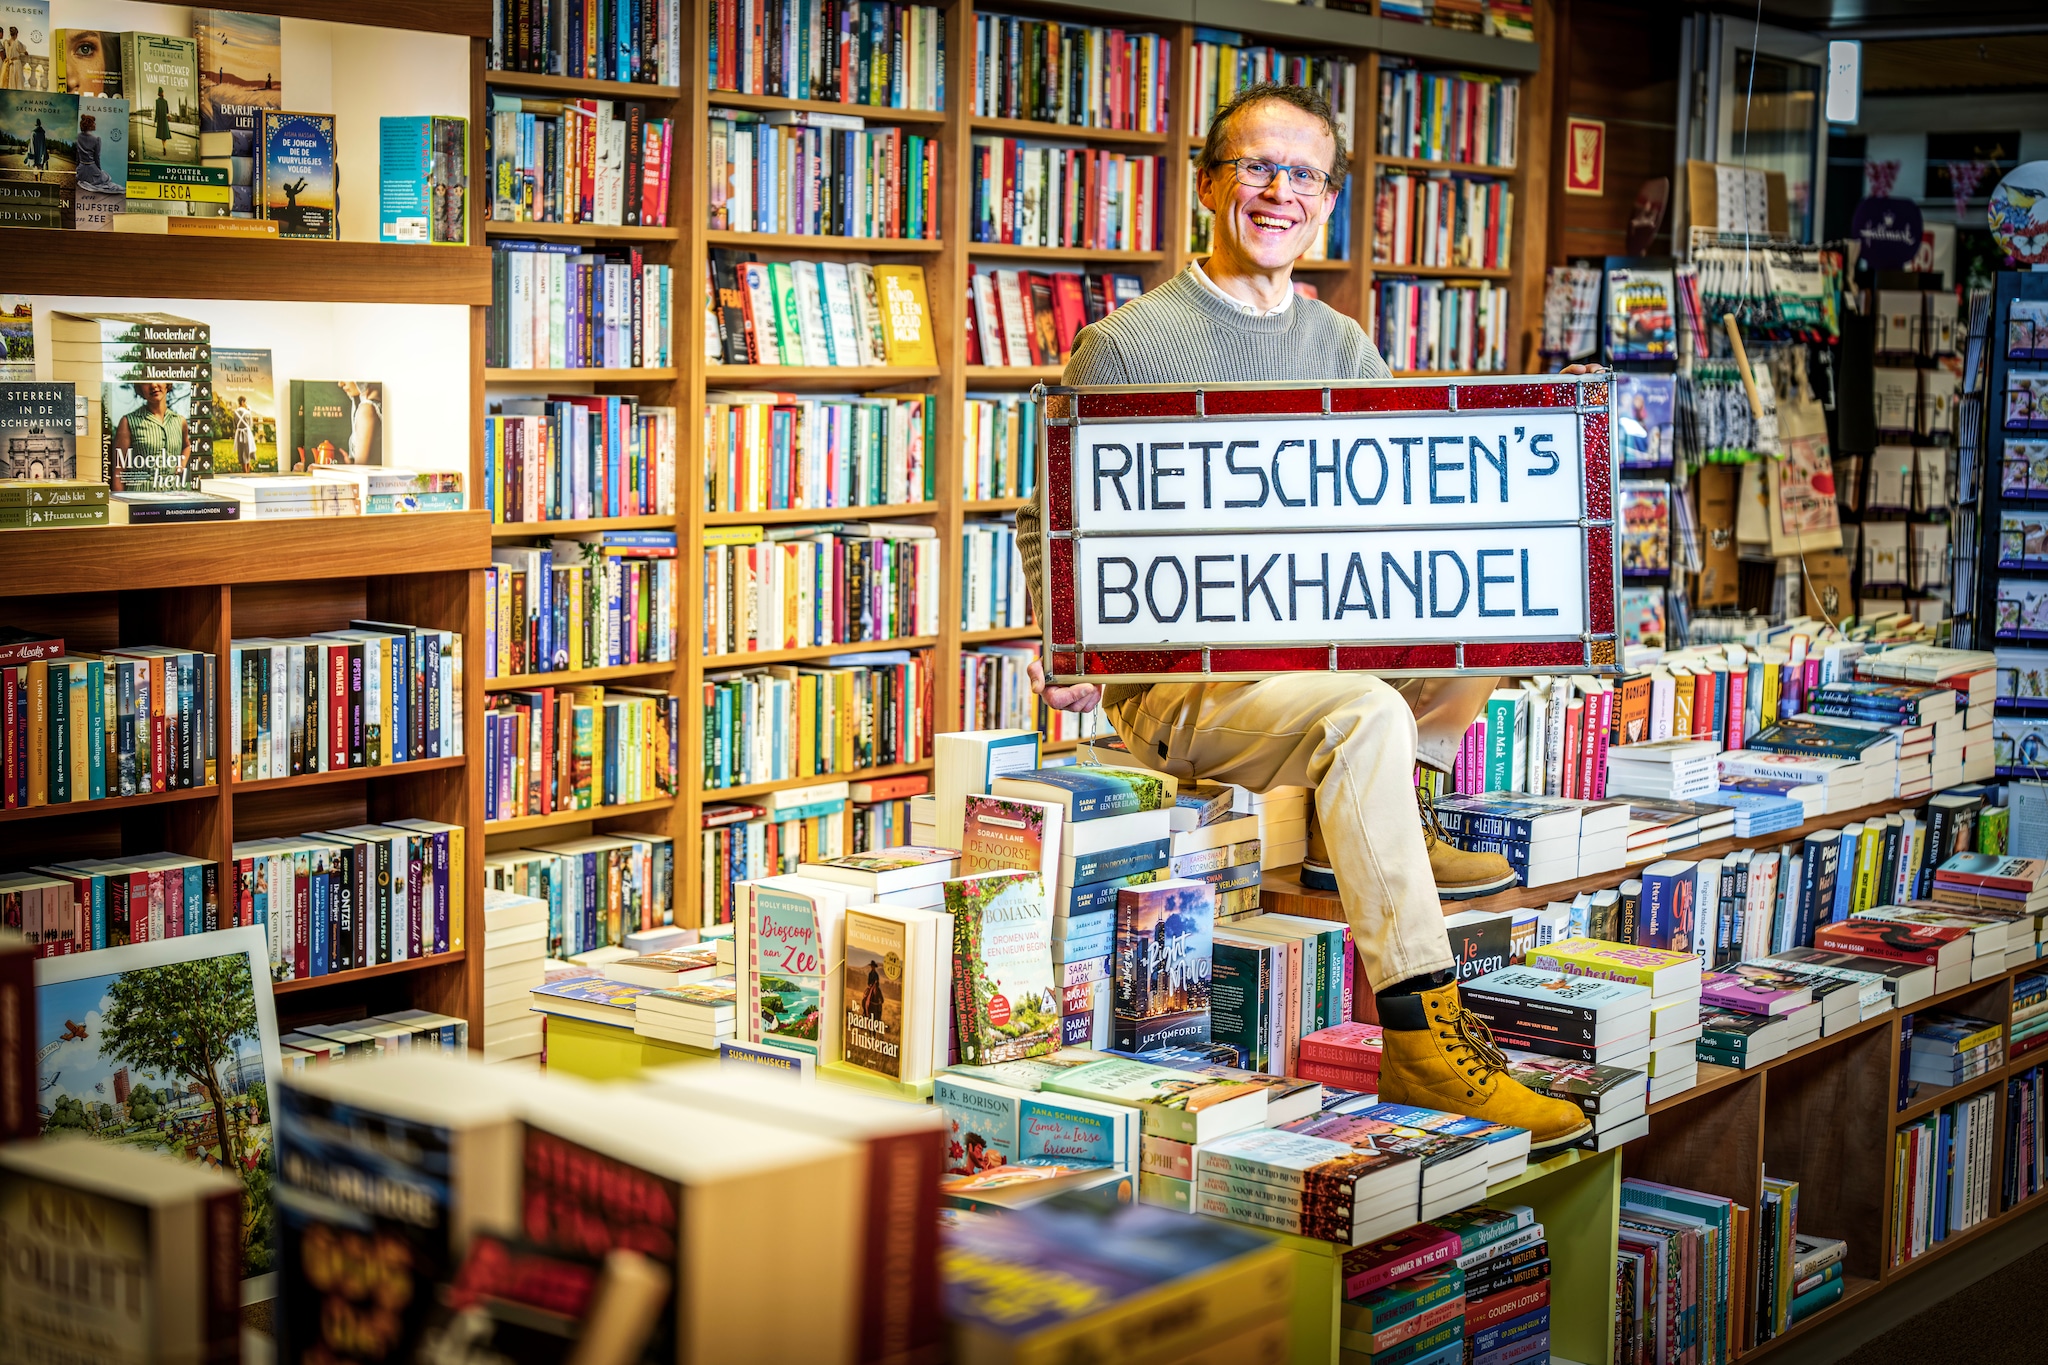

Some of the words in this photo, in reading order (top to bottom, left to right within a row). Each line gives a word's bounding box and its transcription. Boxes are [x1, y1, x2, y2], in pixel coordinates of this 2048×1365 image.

[6, 6, 44, 16] KLASSEN
[143, 62, 153, 73] DE
[154, 64, 191, 77] ONTDEKKER
[145, 73, 158, 84] VAN
[159, 75, 169, 85] HET
[170, 76, 189, 88] LEVEN
[15, 106, 61, 115] SKENANDORE
[86, 105, 124, 114] KLASSEN
[282, 138, 292, 147] DE
[293, 139, 317, 148] JONGEN
[289, 148, 300, 156] DIE
[301, 148, 309, 157] DE
[277, 156, 322, 166] VUURVLIEGJES
[166, 167, 201, 176] DOCHTER
[287, 165, 311, 174] VOLGDE
[158, 184, 191, 199] JESCA
[597, 166, 608, 207] Nexus
[611, 176, 621, 210] Nexus
[88, 215, 106, 223] ZEE
[886, 276, 899, 289] JE
[889, 290, 914, 301] KIND
[890, 303, 901, 314] IS
[902, 303, 922, 315] EEN
[891, 315, 921, 328] GOUD
[144, 327, 196, 340] Moederheil
[894, 329, 920, 341] MIJN
[145, 347, 197, 360] Moederheil
[146, 366, 198, 379] Moederheil
[226, 374, 253, 383] kliniek
[7, 391, 62, 401] STERREN
[19, 405, 29, 415] IN
[39, 405, 53, 415] DE
[0, 418, 72, 428] SCHEMERING
[115, 448, 186, 469] Moeder
[1092, 426, 1560, 511] RIETSCHOTEN's
[153, 467, 188, 488] heil
[1098, 548, 1559, 624] BOEKHANDEL
[336, 656, 344, 696] ONTWAKEN
[353, 658, 361, 691] OPSTAND
[1625, 680, 1650, 700] ROOKGAT
[1590, 696, 1598, 715] DON
[95, 717, 101, 726] De
[138, 687, 148, 743] Vlindermeisje
[1497, 706, 1507, 735] Geert
[1589, 717, 1596, 729] DE
[91, 727, 101, 767] bannelingen
[1496, 736, 1505, 758] Mak
[1587, 731, 1595, 754] JONG
[1754, 767, 1802, 780] ORGANISCH
[1438, 814, 1461, 831] PULLEY
[1479, 817, 1502, 836] LETTER
[1503, 821, 1511, 836] M
[1934, 812, 1942, 829] BILL
[977, 829, 1003, 840] SORAYA
[1005, 832, 1024, 843] LANE
[970, 840, 985, 851] DE
[987, 844, 1031, 861] NOORSE
[1930, 830, 1940, 864] CLINTON
[969, 855, 1029, 871] DOCHTER
[1190, 854, 1206, 863] KAREN
[1206, 852, 1222, 860] SWAN
[1190, 859, 1228, 872] STORMGLOED
[1206, 874, 1222, 883] SWAN
[1219, 877, 1249, 890] VERLANGEN
[1652, 882, 1661, 902] Peter
[1701, 881, 1710, 906] Virginia
[342, 889, 350, 931] ONTZET
[759, 900, 780, 910] HOLLY
[782, 902, 811, 914] HEPBURN
[985, 904, 1041, 924] BOMANN
[1625, 900, 1635, 936] laatste
[1650, 903, 1660, 935] Buwalda
[1700, 908, 1708, 935] Mendoza
[760, 915, 813, 942] Bioscoop
[850, 931, 880, 943] NICHOLAS
[881, 937, 901, 948] EVANS
[993, 934, 1025, 945] DROMEN
[1026, 932, 1039, 940] VAN
[1824, 940, 1836, 948] ROB
[1837, 942, 1848, 950] VAN
[1849, 943, 1864, 952] ESSEN
[988, 948, 1002, 957] EEN
[1002, 945, 1025, 955] NIEUW
[1027, 941, 1046, 950] BEGIN
[1148, 931, 1191, 973] Right
[1462, 938, 1478, 964] Je
[763, 948, 782, 958] aan
[781, 945, 818, 974] Zee
[1454, 954, 1502, 978] leven
[1069, 963, 1092, 975] SARAH
[1071, 974, 1089, 985] LARK
[1170, 959, 1208, 996] Move
[1066, 987, 1090, 1001] SARAH
[852, 1000, 861, 1011] De
[1069, 999, 1088, 1011] LARK
[847, 1011, 889, 1035] paarden-
[1066, 1017, 1090, 1031] SARAH
[1069, 1029, 1087, 1041] LARK
[1143, 1034, 1156, 1043] LIZ
[1157, 1026, 1202, 1039] TOMFORDE
[1701, 1037, 1717, 1046] Parijs
[851, 1031, 898, 1058] fluisteraar
[728, 1050, 755, 1063] SUSAN
[756, 1055, 791, 1070] MUSKEE
[1699, 1053, 1715, 1062] Parijs
[941, 1087, 959, 1100] B.K.
[962, 1092, 1009, 1113] BORISON
[1032, 1107, 1052, 1118] JANA
[1054, 1112, 1101, 1127] SCHIKORRA
[1028, 1117, 1063, 1135] Zomer
[1235, 1163, 1256, 1175] VOOR
[1256, 1167, 1278, 1179] ALTIJD
[1279, 1172, 1289, 1182] BIJ
[1290, 1175, 1300, 1184] MIJ
[1232, 1184, 1253, 1197] VOOR
[1254, 1189, 1276, 1201] ALTIJD
[1277, 1194, 1287, 1203] BIJ
[1288, 1197, 1298, 1206] MIJ
[1231, 1206, 1252, 1218] VOOR
[1252, 1210, 1275, 1223] ALTIJD
[1276, 1216, 1286, 1225] BIJ
[1286, 1218, 1297, 1228] MIJ
[1478, 1220, 1515, 1244] Kerstverhalen
[1390, 1260, 1414, 1277] SUMMER
[1416, 1258, 1422, 1267] IN
[1423, 1253, 1434, 1264] THE
[1436, 1247, 1449, 1260] CITY
[1512, 1251, 1537, 1266] MISTLETOE
[1514, 1267, 1539, 1283] MISTLETOE
[1416, 1296, 1425, 1307] THE
[1424, 1292, 1435, 1304] LOVE
[1436, 1285, 1451, 1300] HATERS
[1488, 1302, 1517, 1319] GOUDEN
[1518, 1292, 1539, 1309] LOTUS
[1378, 1326, 1402, 1343] Kimberley
[1476, 1331, 1499, 1345] CHARLOTTE
